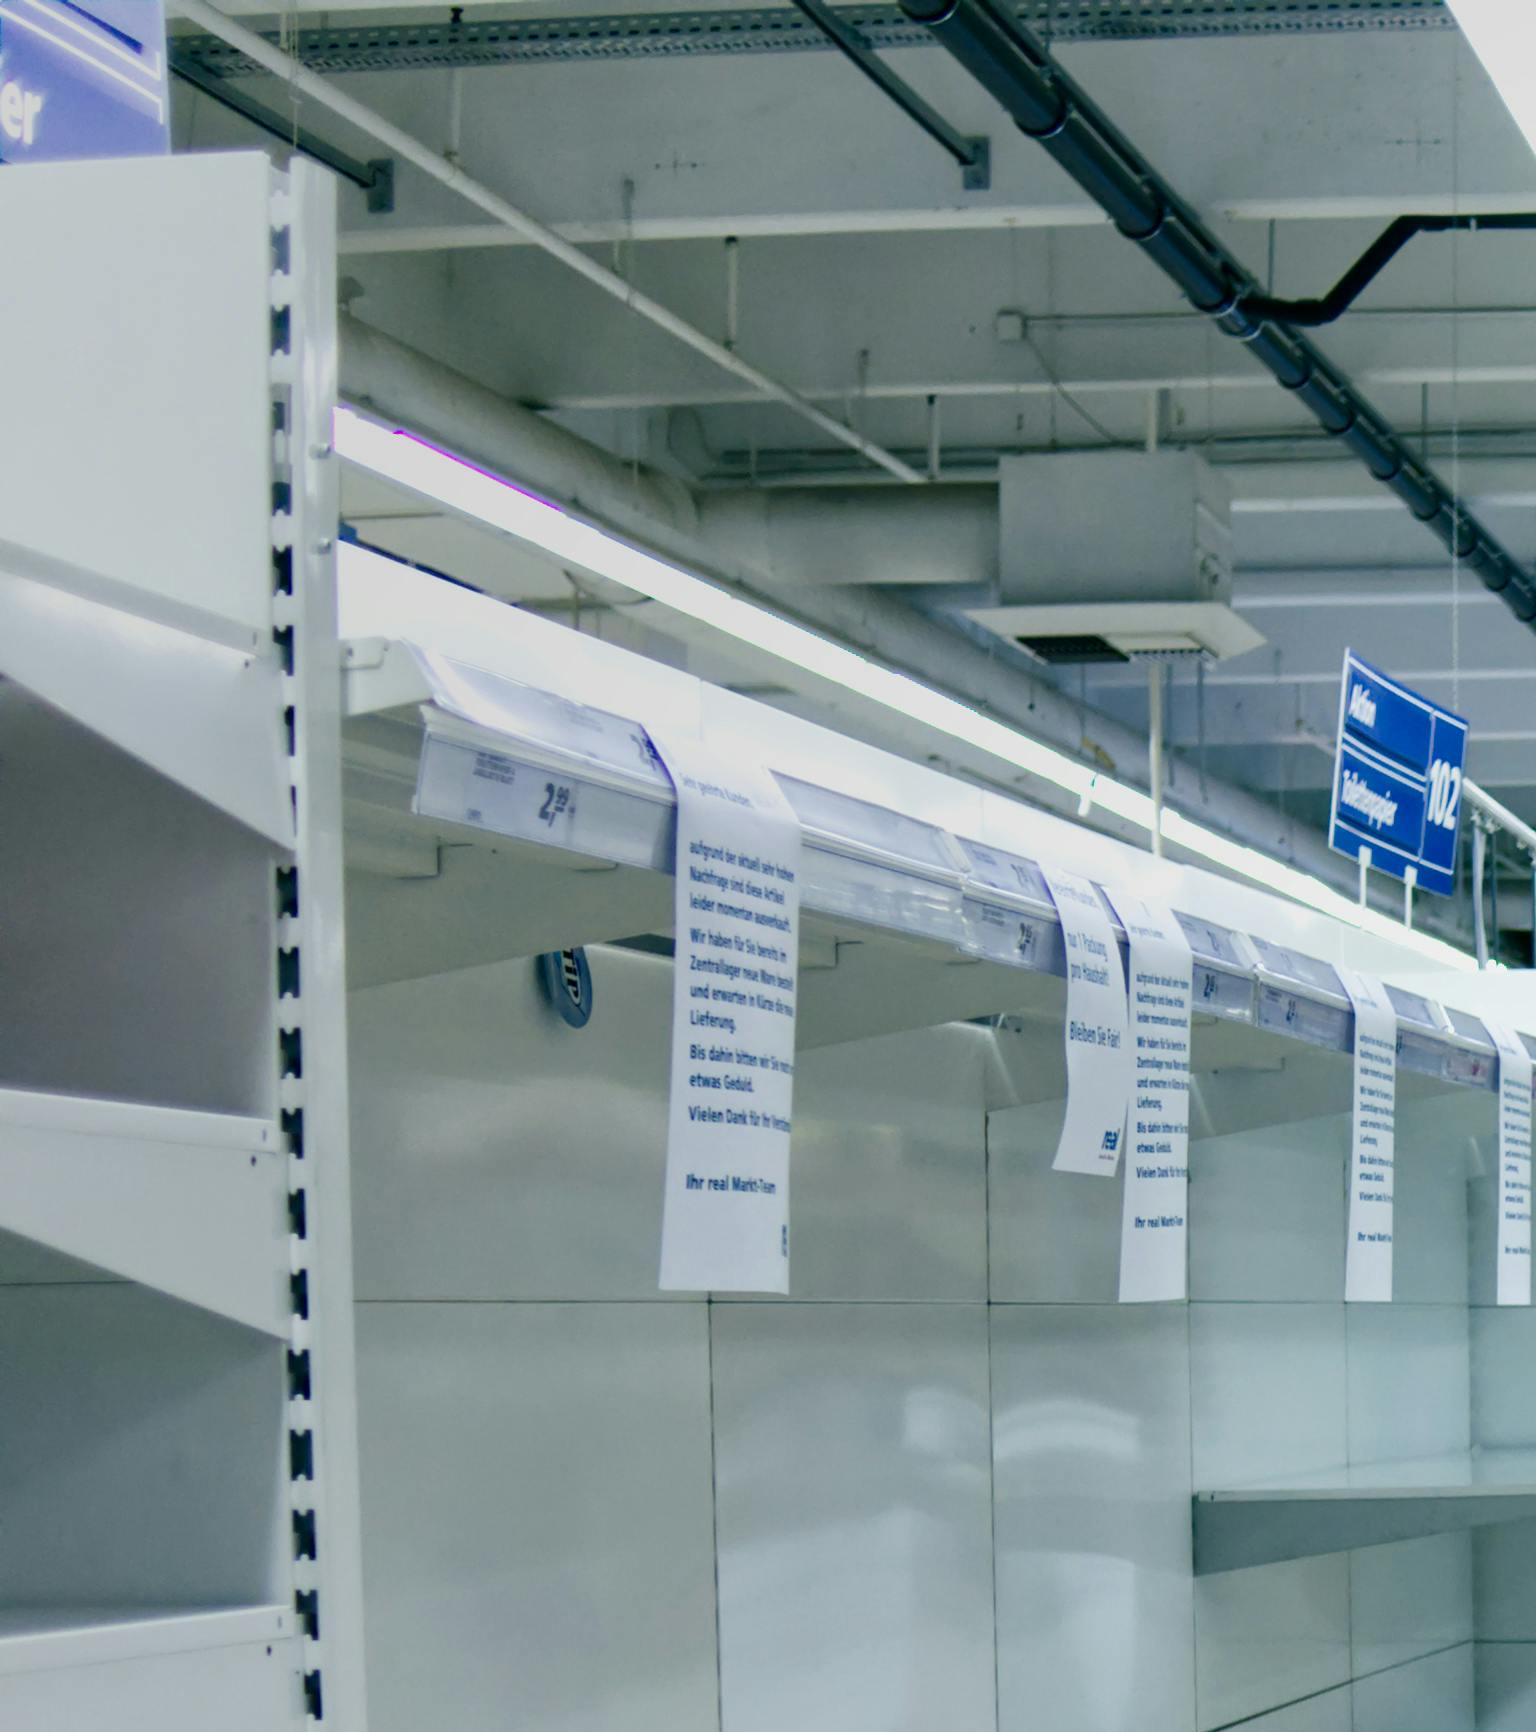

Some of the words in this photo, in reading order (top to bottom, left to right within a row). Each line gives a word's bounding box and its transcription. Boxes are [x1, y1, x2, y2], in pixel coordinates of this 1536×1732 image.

[1428, 758, 1461, 830] 102
[689, 840, 724, 861] aufgrund
[725, 848, 736, 864] der
[761, 861, 775, 876] sehr
[690, 866, 729, 892] Nachfrage
[730, 875, 744, 893] sind
[746, 880, 762, 898] diese
[690, 892, 715, 912] leider
[717, 901, 753, 921] momentan
[690, 927, 706, 944] Wir
[709, 929, 733, 949] haben
[734, 936, 744, 952] für
[745, 939, 756, 955] Sie
[757, 941, 778, 961] bereits
[690, 955, 740, 980] Zentrallager
[743, 968, 759, 981] neue
[690, 983, 709, 999] und
[712, 989, 747, 1006] erwarten
[1070, 1021, 1096, 1044] Bleiben
[1097, 1025, 1107, 1047] Sie
[1108, 1028, 1121, 1050] Fair!
[690, 1044, 706, 1060] Bis
[709, 1046, 734, 1063] dahin
[736, 1048, 758, 1067] bitten
[689, 1073, 721, 1089] etwas
[724, 1075, 754, 1093] Geduld.
[688, 1105, 724, 1123] Vielen
[726, 1108, 747, 1126] Dank
[750, 1111, 761, 1127] für
[1101, 1128, 1121, 1152] real
[686, 1173, 705, 1191] Ihr
[708, 1176, 729, 1192] real
